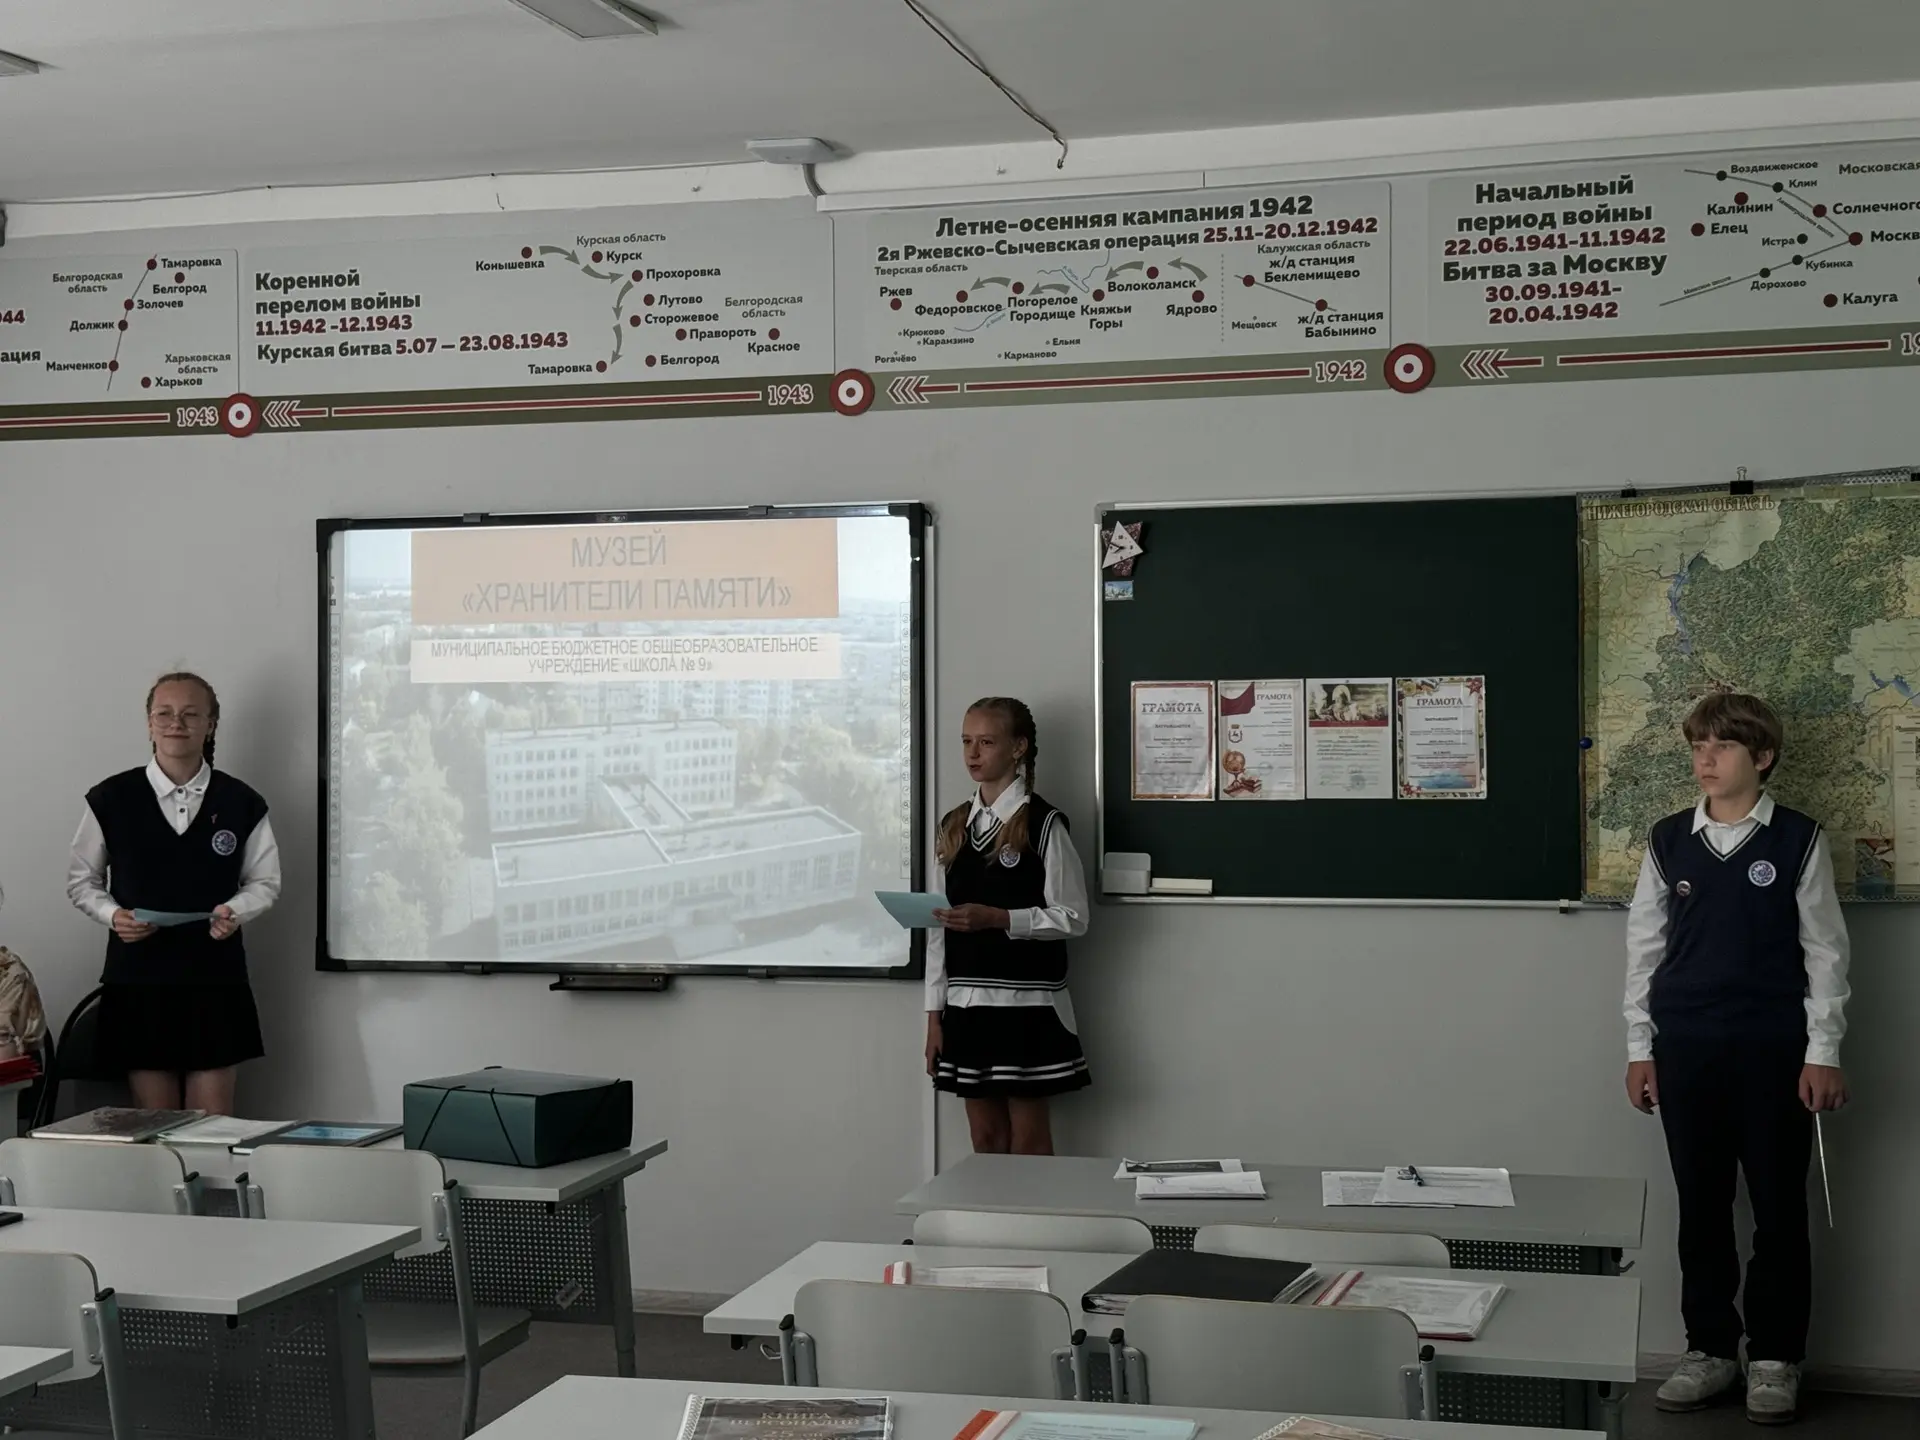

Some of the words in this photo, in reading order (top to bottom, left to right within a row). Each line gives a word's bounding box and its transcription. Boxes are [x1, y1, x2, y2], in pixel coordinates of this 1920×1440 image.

[1731, 161, 1818, 174] Воздвиженское
[1475, 173, 1634, 204] Начальный
[1789, 179, 1818, 189] Клин
[936, 211, 1117, 238] Летне-осенняя
[1122, 203, 1244, 228] кампания
[1249, 195, 1313, 217] 1942
[1707, 203, 1773, 216] Калинин
[1457, 211, 1556, 236] период
[1562, 203, 1652, 226] войны
[1711, 222, 1748, 235] Елец
[576, 234, 620, 246] Курская
[624, 232, 666, 243] область
[877, 246, 900, 262] 2я
[904, 238, 1100, 262] Ржевско-Сычевская
[1104, 231, 1199, 251] операция
[1203, 218, 1378, 243] 25.11-20.12.1942
[1444, 226, 1666, 256] 22.06.1941-11.1942
[1762, 237, 1795, 248] Истра
[1257, 242, 1321, 255] Калужская
[1324, 239, 1371, 250] область
[161, 257, 222, 270] Тамаровка
[607, 251, 642, 264] Курск
[1269, 256, 1296, 270] ж/д
[1299, 254, 1355, 267] станция
[475, 258, 545, 272] Конышевка
[874, 265, 923, 277] Тверская
[925, 262, 968, 274] область
[1443, 261, 1522, 282] Битва
[1527, 261, 1557, 278] за
[1563, 254, 1668, 276] Москву
[1805, 259, 1853, 271] Кубинка
[53, 271, 123, 284] Белгородская
[646, 266, 721, 281] Прохоровка
[1264, 268, 1360, 284] Беклемищево
[255, 270, 360, 294] Коренной
[1108, 279, 1197, 293] Волоколамск
[1750, 278, 1807, 291] Дорохово
[68, 285, 108, 294] область
[152, 283, 207, 296] Белгород
[879, 286, 913, 299] Ржев
[1485, 279, 1622, 303] 30.09.1941-
[137, 299, 184, 309] Золочев
[256, 297, 346, 318] перелом
[350, 292, 421, 311] войны
[658, 294, 703, 306] Лутово
[725, 294, 803, 308] Белгородская
[1008, 295, 1078, 309] Погорелое
[1843, 292, 1899, 307] Калуга
[742, 308, 786, 319] область
[914, 302, 1002, 317] Федоровское
[1010, 309, 1076, 324] Городище
[1081, 304, 1132, 317] Княжьи
[1166, 304, 1217, 317] Ядрово
[1488, 302, 1619, 325] 20.04.1942
[645, 311, 719, 326] Сторожевое
[1089, 318, 1123, 332] Горы
[1298, 312, 1324, 326] ж/д
[1327, 310, 1384, 324] станция
[69, 320, 114, 332] Должик
[256, 318, 326, 336] 11.1942
[1232, 320, 1277, 331] Мещовск
[1305, 325, 1377, 339] Бабынино
[690, 327, 757, 341] Правороть
[903, 328, 945, 338] Крюково
[257, 343, 335, 365] Курская
[339, 340, 392, 357] битва
[396, 337, 437, 354] 5.07
[459, 332, 568, 352] 23.08.1943
[748, 341, 800, 354] Красное
[923, 337, 974, 346] Карамзино
[1052, 337, 1081, 347] Ельня
[165, 353, 231, 365] Харьковская
[660, 353, 720, 367] Белгород
[874, 354, 917, 365] Рогачёво
[1004, 351, 1057, 361] Карманово
[46, 361, 108, 372] Манченков
[178, 365, 218, 375] область
[528, 363, 592, 376] Тамаровка
[1315, 360, 1366, 382] 1942
[155, 377, 203, 389] Харьков
[768, 385, 813, 405] 1943
[177, 406, 219, 427] 1943
[1587, 500, 1708, 520] НИЖЕГОРОДСКАЯ
[1712, 495, 1775, 512] ОБЛАСТЬ
[572, 528, 667, 568] МУЗЕЙ
[462, 579, 644, 614] «ХРАНИТЕЛИ
[653, 576, 793, 611] ПАМЯТИ»
[431, 641, 549, 660] МУНИЦИПАЛЬНОЕ
[552, 640, 638, 658] БЮДЖЕТНОЕ
[642, 637, 818, 656] ОБЩЕОБРАЗОВАТЕЛЬНОЕ
[528, 658, 619, 676] УЧРЕЖДЕНИЕ
[622, 656, 677, 673] «ШКОЛА
[680, 657, 696, 673] №
[1256, 693, 1292, 701] ГРАМОТА
[1416, 698, 1463, 706] ГРАМОТА
[1142, 702, 1202, 713] ГРАМОТА
